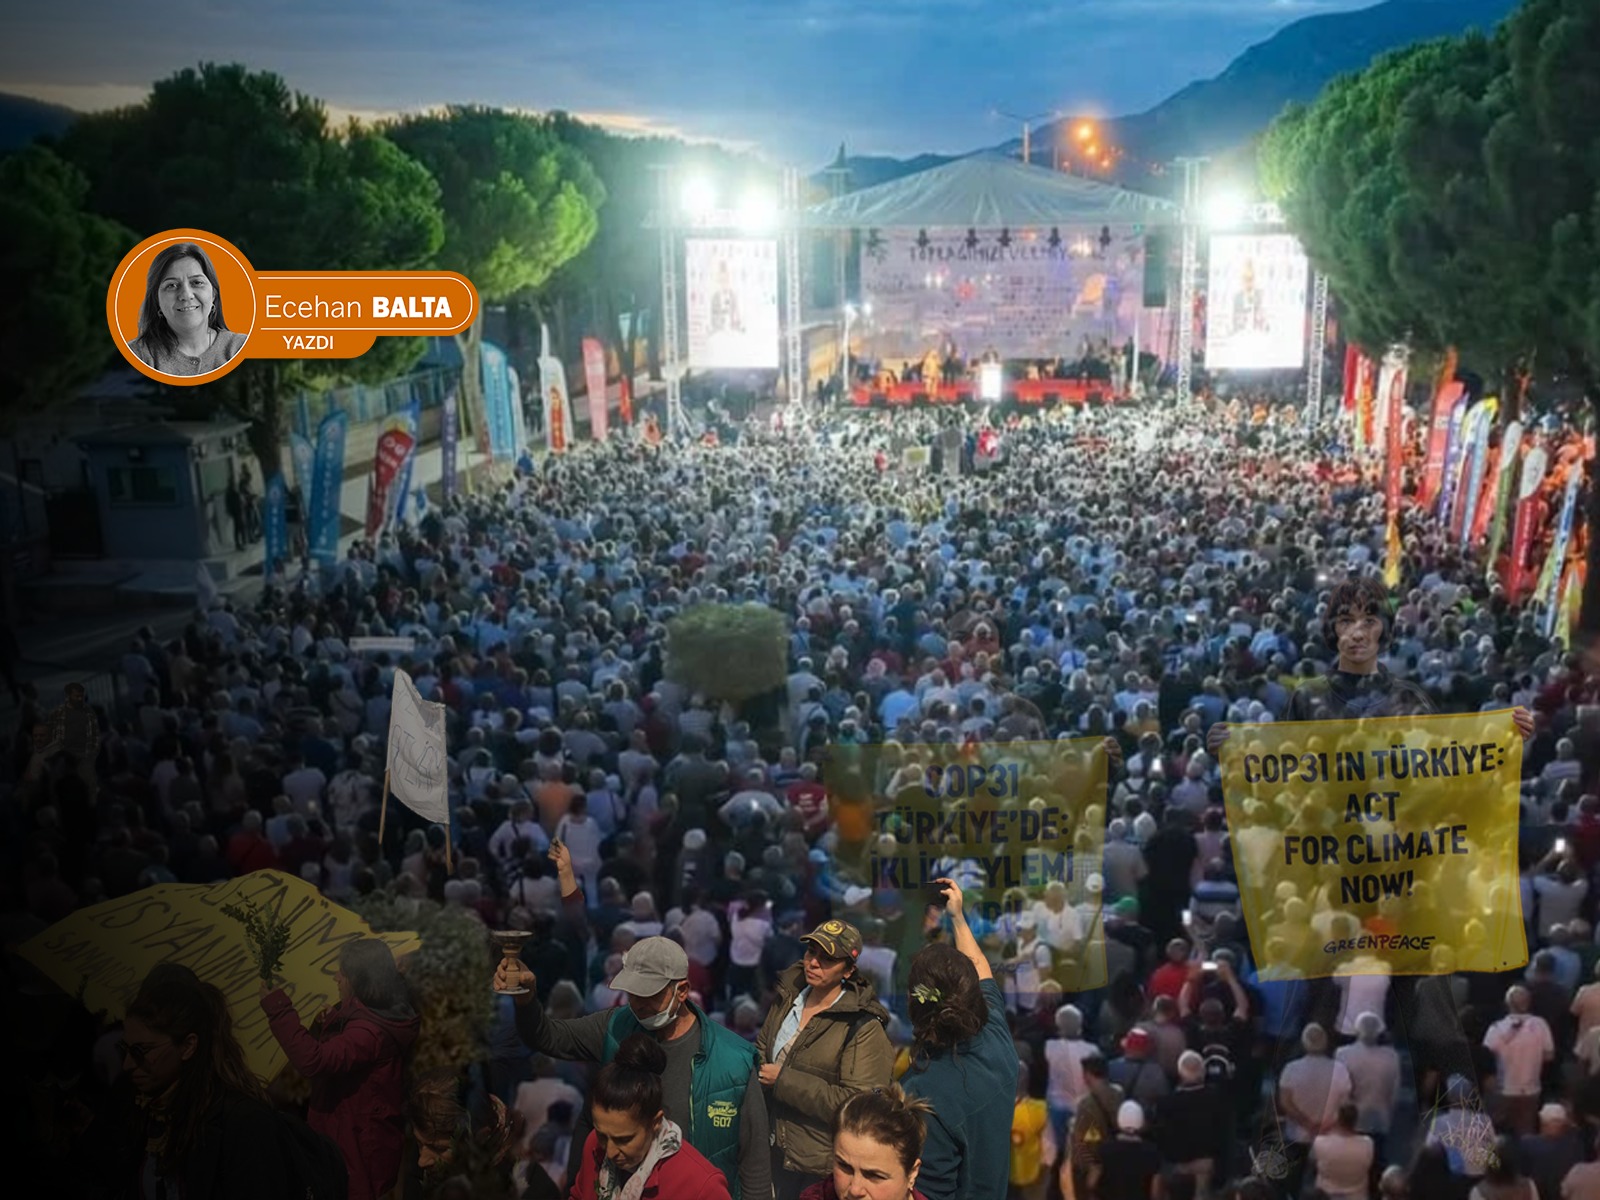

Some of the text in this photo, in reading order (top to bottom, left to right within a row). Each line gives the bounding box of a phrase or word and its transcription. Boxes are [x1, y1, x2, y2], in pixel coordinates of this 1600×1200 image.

[1243, 741, 1505, 783] COP31 IN TÜRKİYE:
[924, 763, 1019, 797] COP31
[1344, 791, 1401, 822] ACT
[1284, 825, 1469, 865] FOR CLIMATE
[1341, 871, 1415, 904] NOW!
[1324, 935, 1436, 954] GREENPEACE
[713, 1116, 732, 1128] 607
